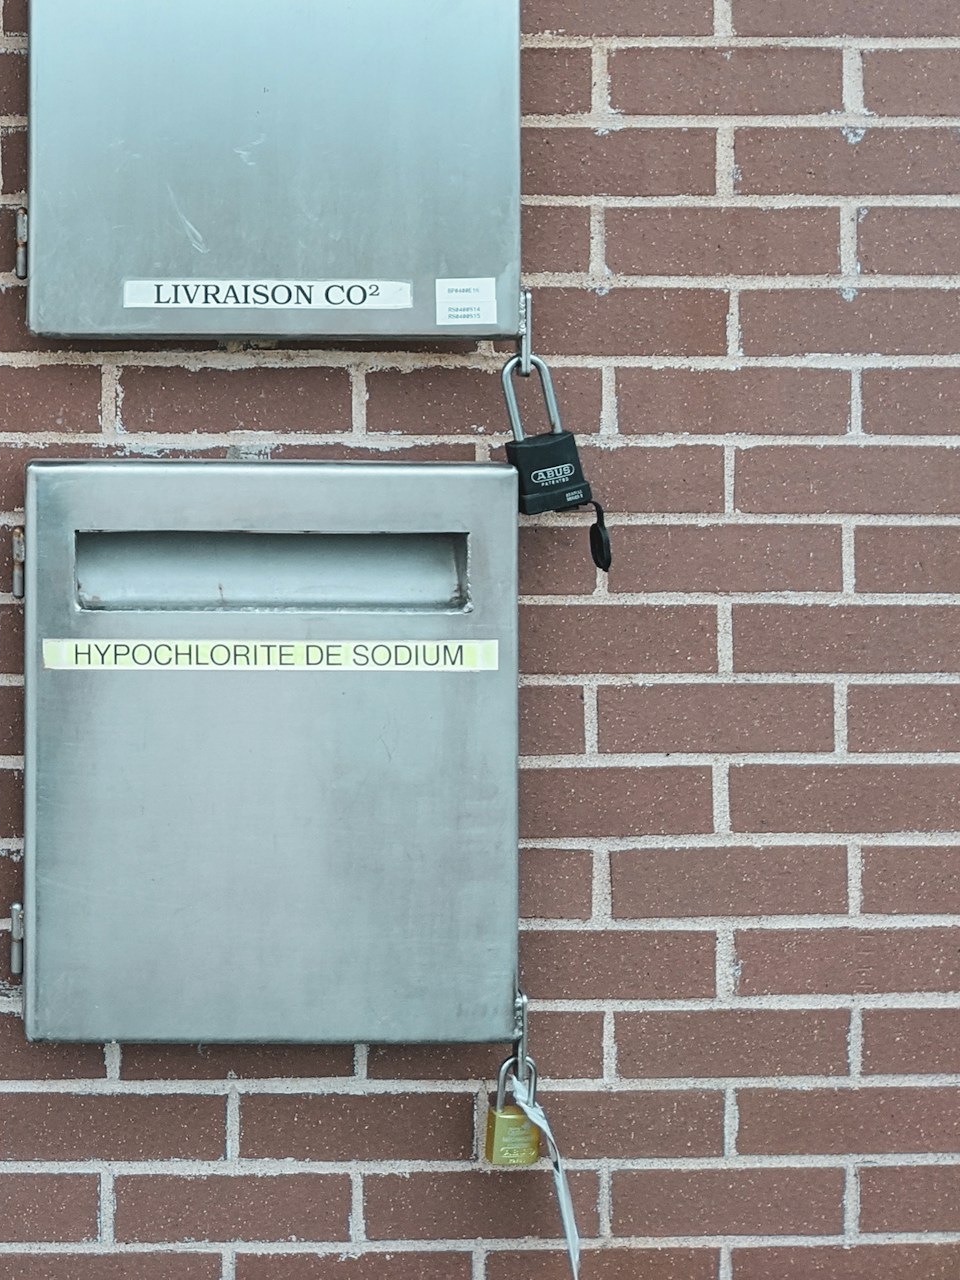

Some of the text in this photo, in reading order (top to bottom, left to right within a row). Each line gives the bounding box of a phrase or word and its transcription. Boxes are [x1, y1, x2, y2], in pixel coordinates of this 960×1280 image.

[153, 283, 316, 306] LIVRAISON
[537, 466, 571, 480] ABUS
[74, 643, 464, 666] HYPOCHLORITE DE SODIUM
